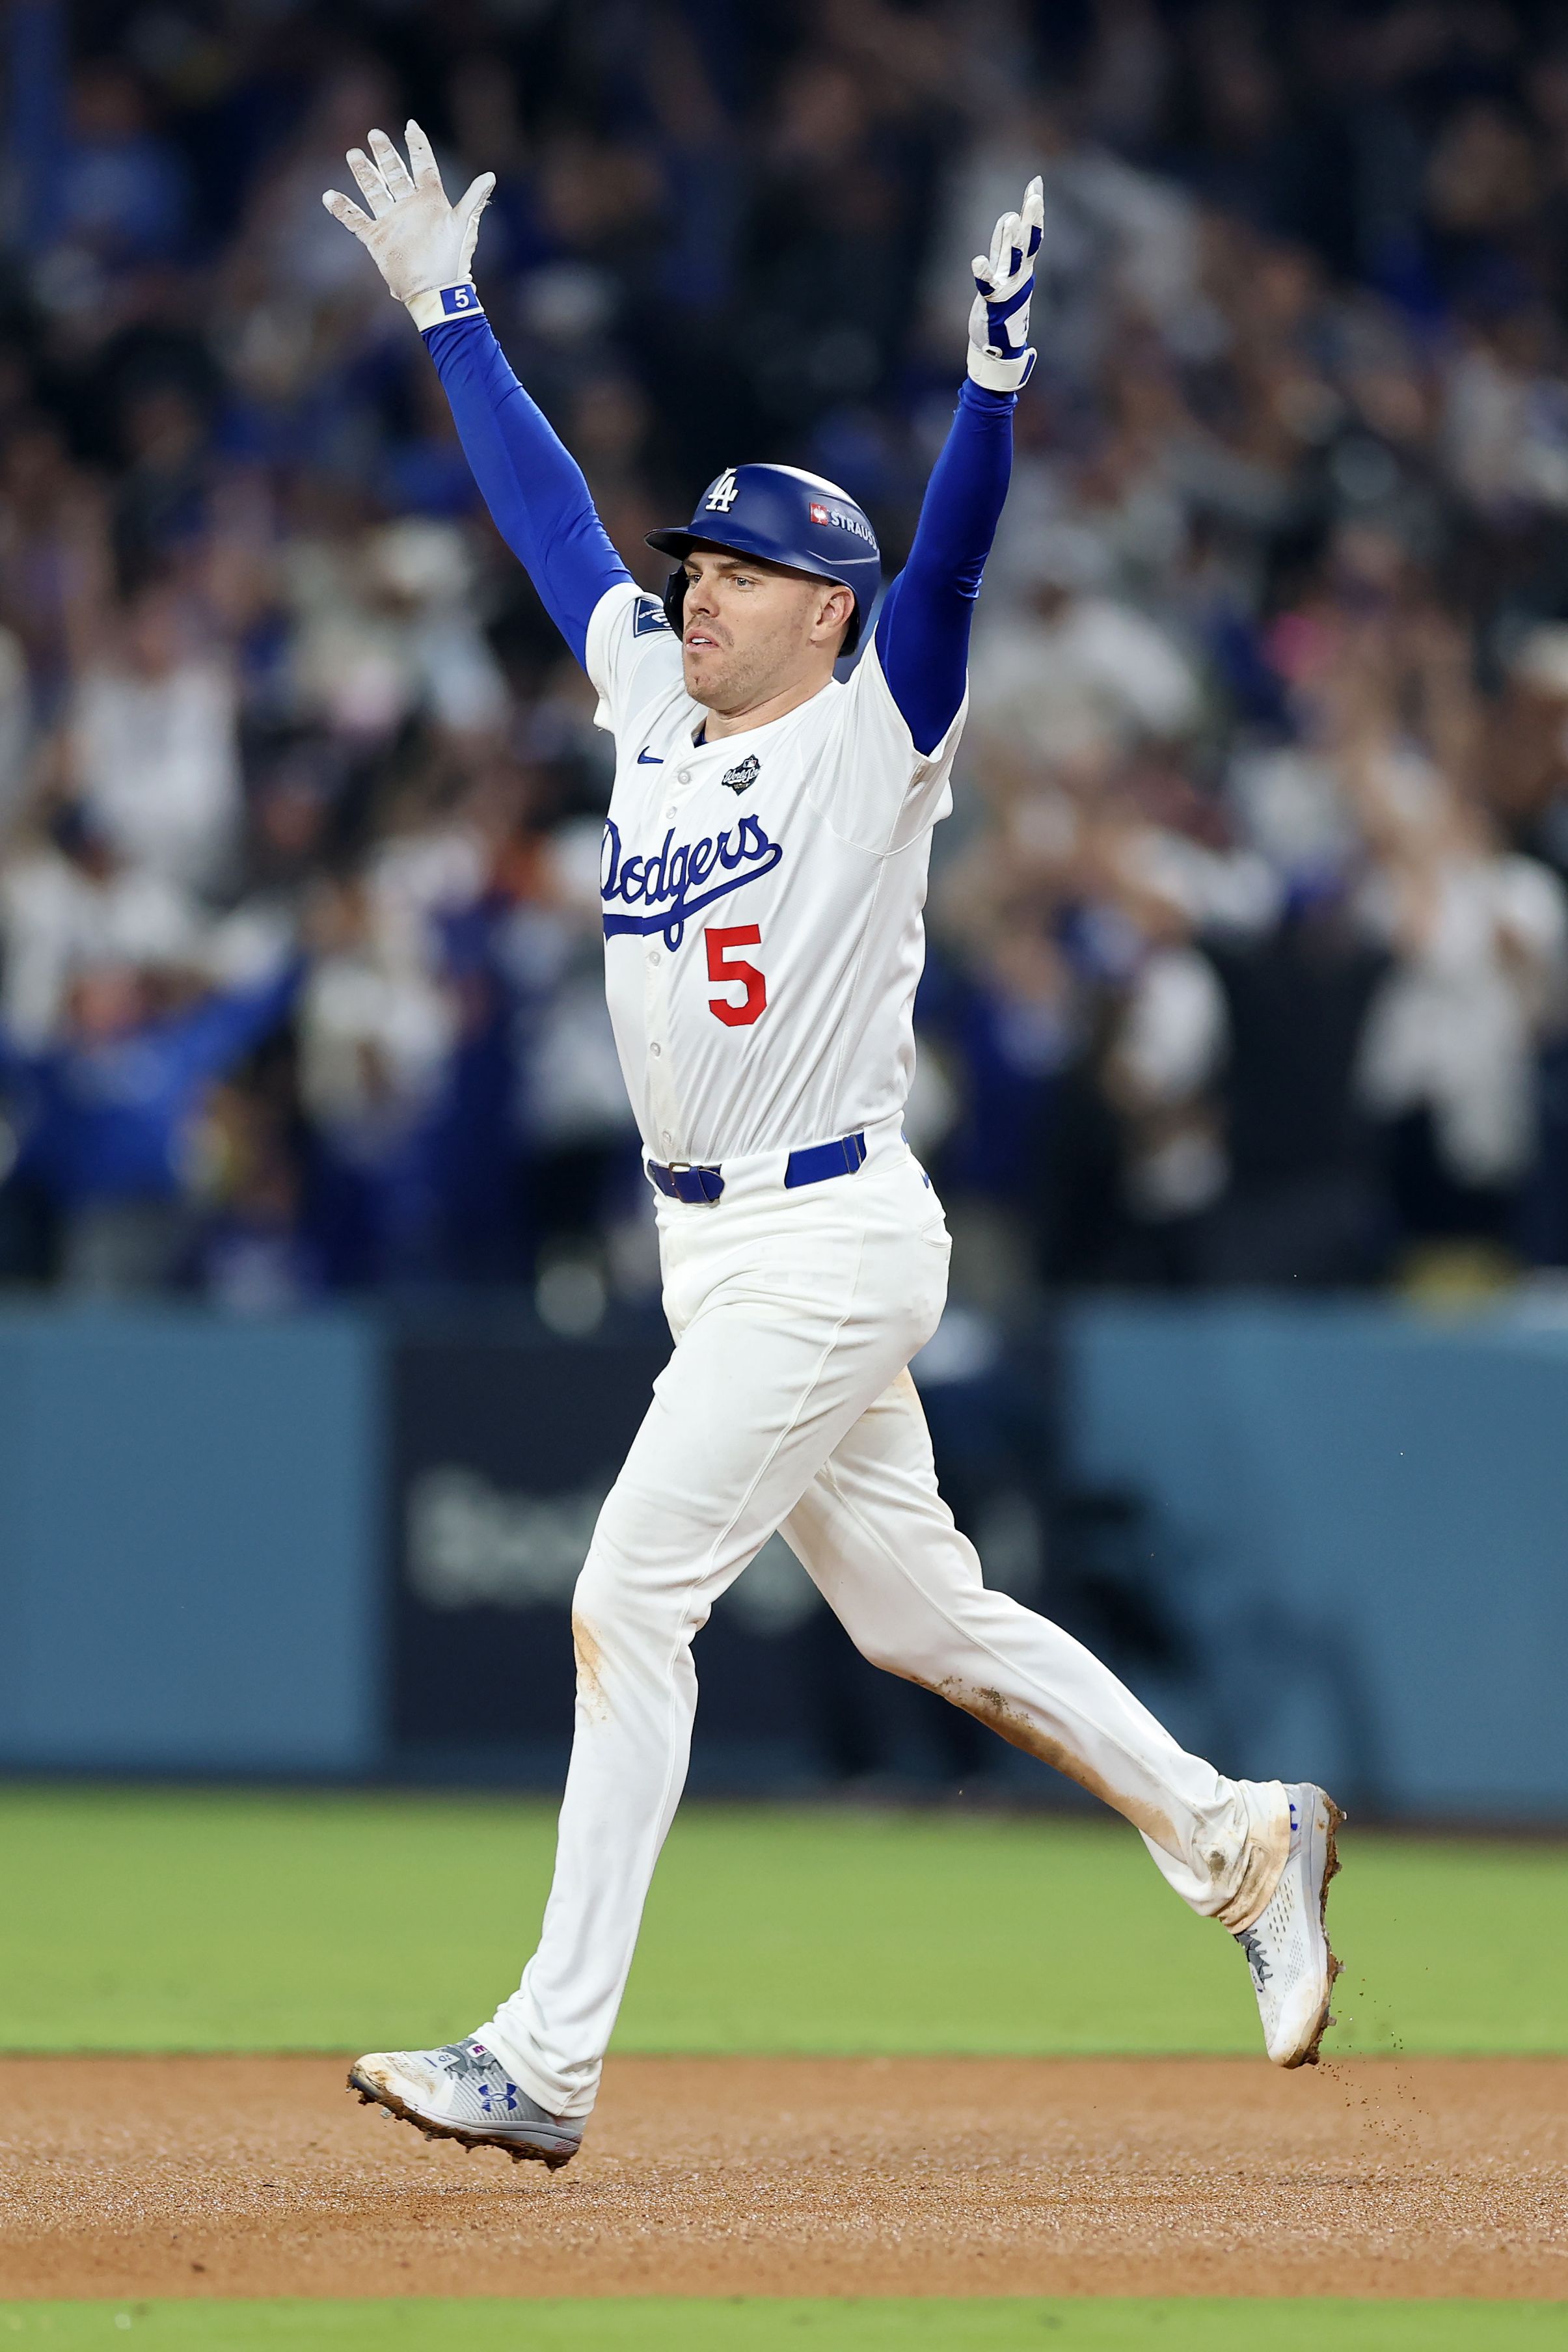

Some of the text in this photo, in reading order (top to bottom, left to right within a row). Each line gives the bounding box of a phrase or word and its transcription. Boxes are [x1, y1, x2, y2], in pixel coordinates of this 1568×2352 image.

[455, 288, 469, 308] 5
[705, 467, 739, 513] LA
[722, 768, 747, 783] World
[600, 813, 783, 953] Dodgers
[704, 923, 767, 1027] 5
